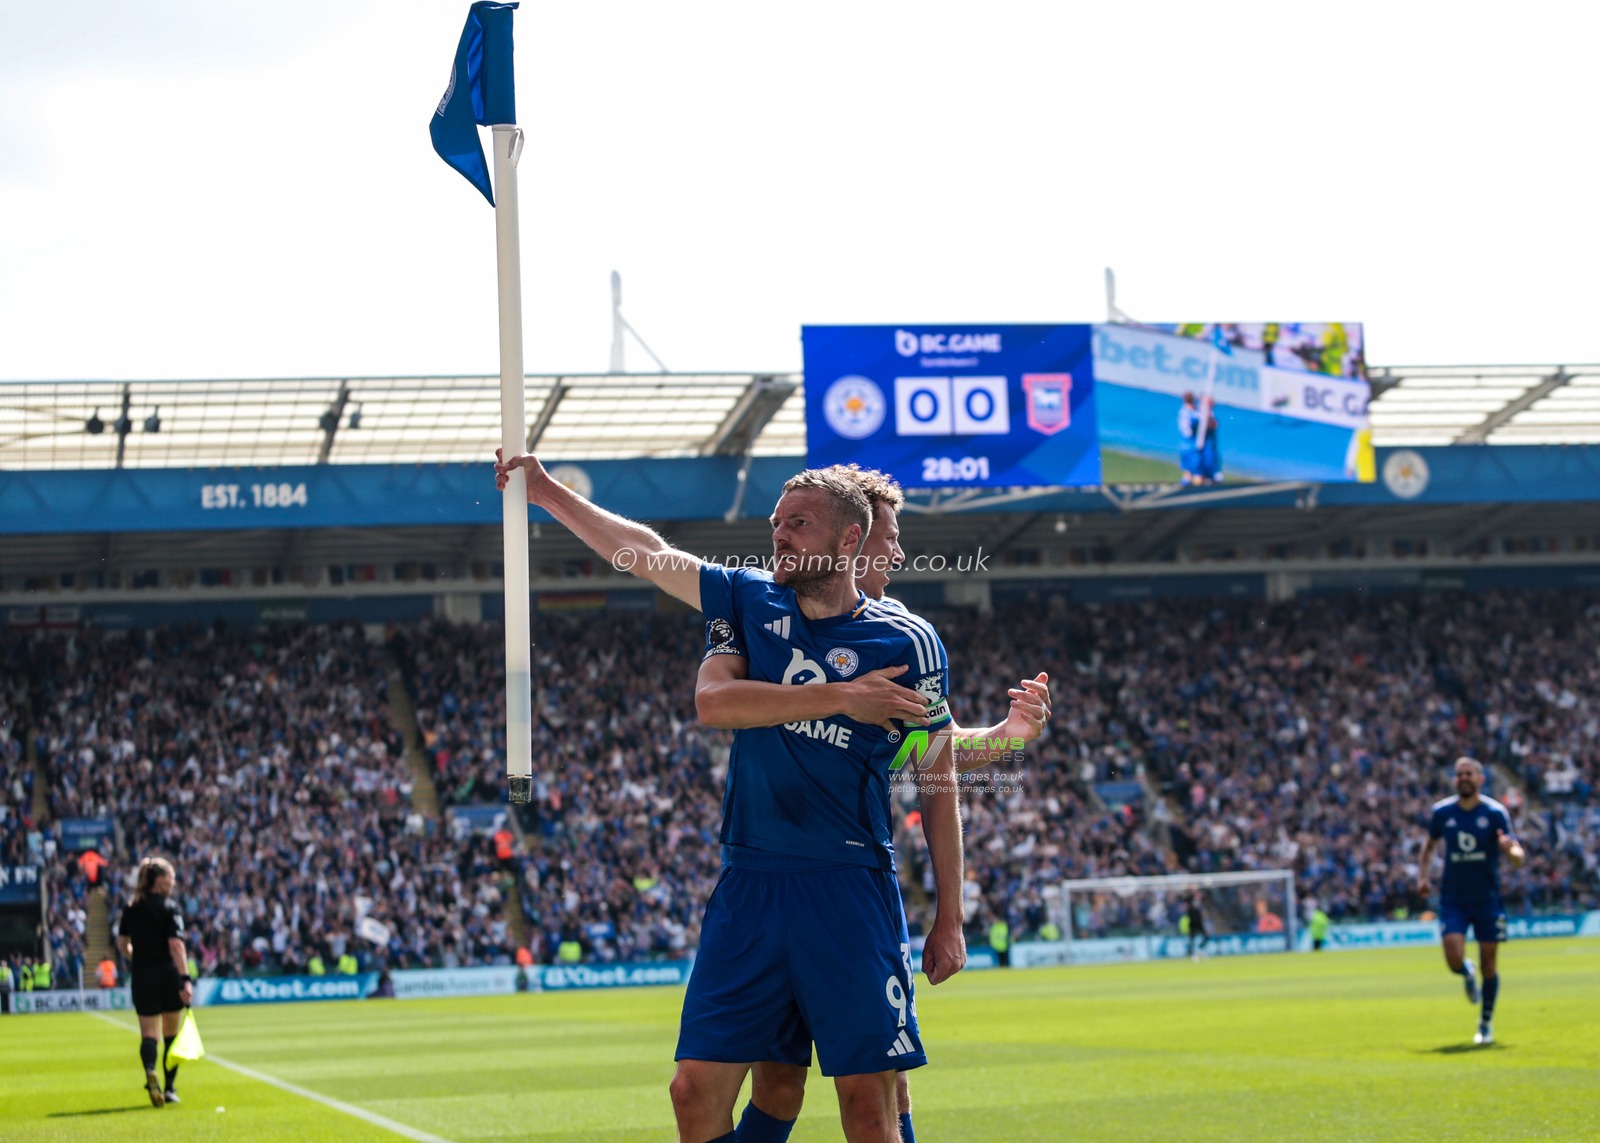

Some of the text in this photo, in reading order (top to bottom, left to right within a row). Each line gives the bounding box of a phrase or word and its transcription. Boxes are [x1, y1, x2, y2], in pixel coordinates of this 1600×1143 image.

[920, 333, 1002, 353] BC.GAME
[910, 388, 938, 423] 0
[966, 388, 994, 421] 0
[921, 457, 990, 481] 28:01
[201, 482, 308, 509] EST. 1884
[885, 975, 907, 1027] 9
